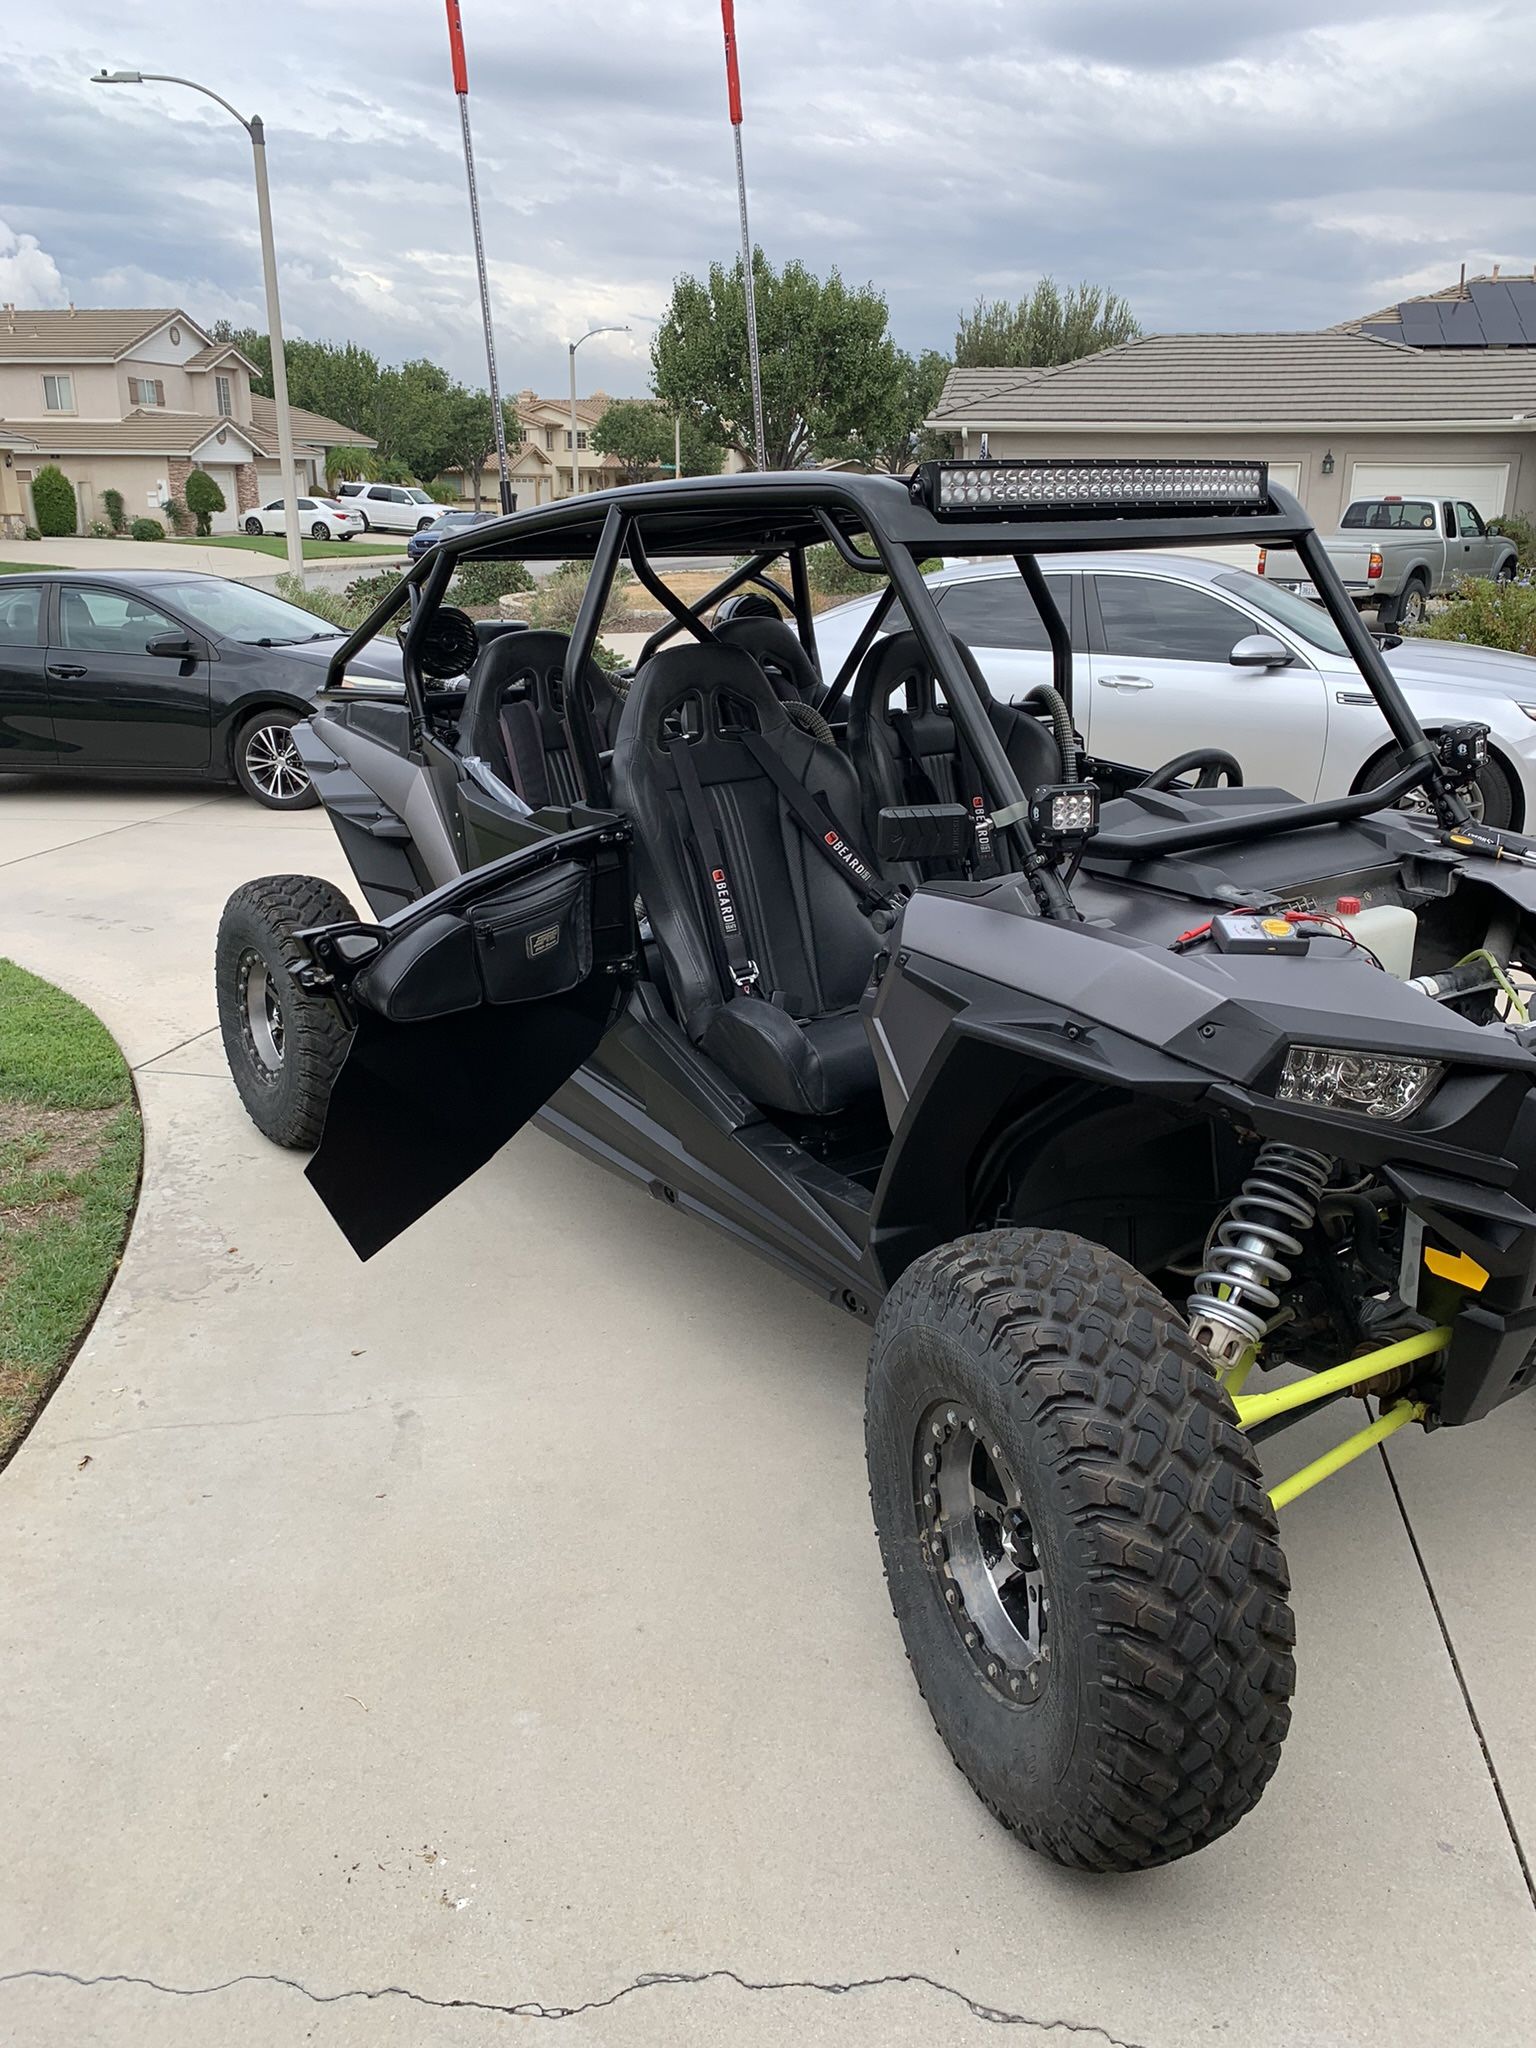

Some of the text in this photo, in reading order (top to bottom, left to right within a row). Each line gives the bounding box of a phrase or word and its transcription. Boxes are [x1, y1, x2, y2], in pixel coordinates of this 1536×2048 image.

[974, 808, 990, 844] BERD
[832, 840, 865, 874] BEARD
[716, 882, 735, 923] BEARD
